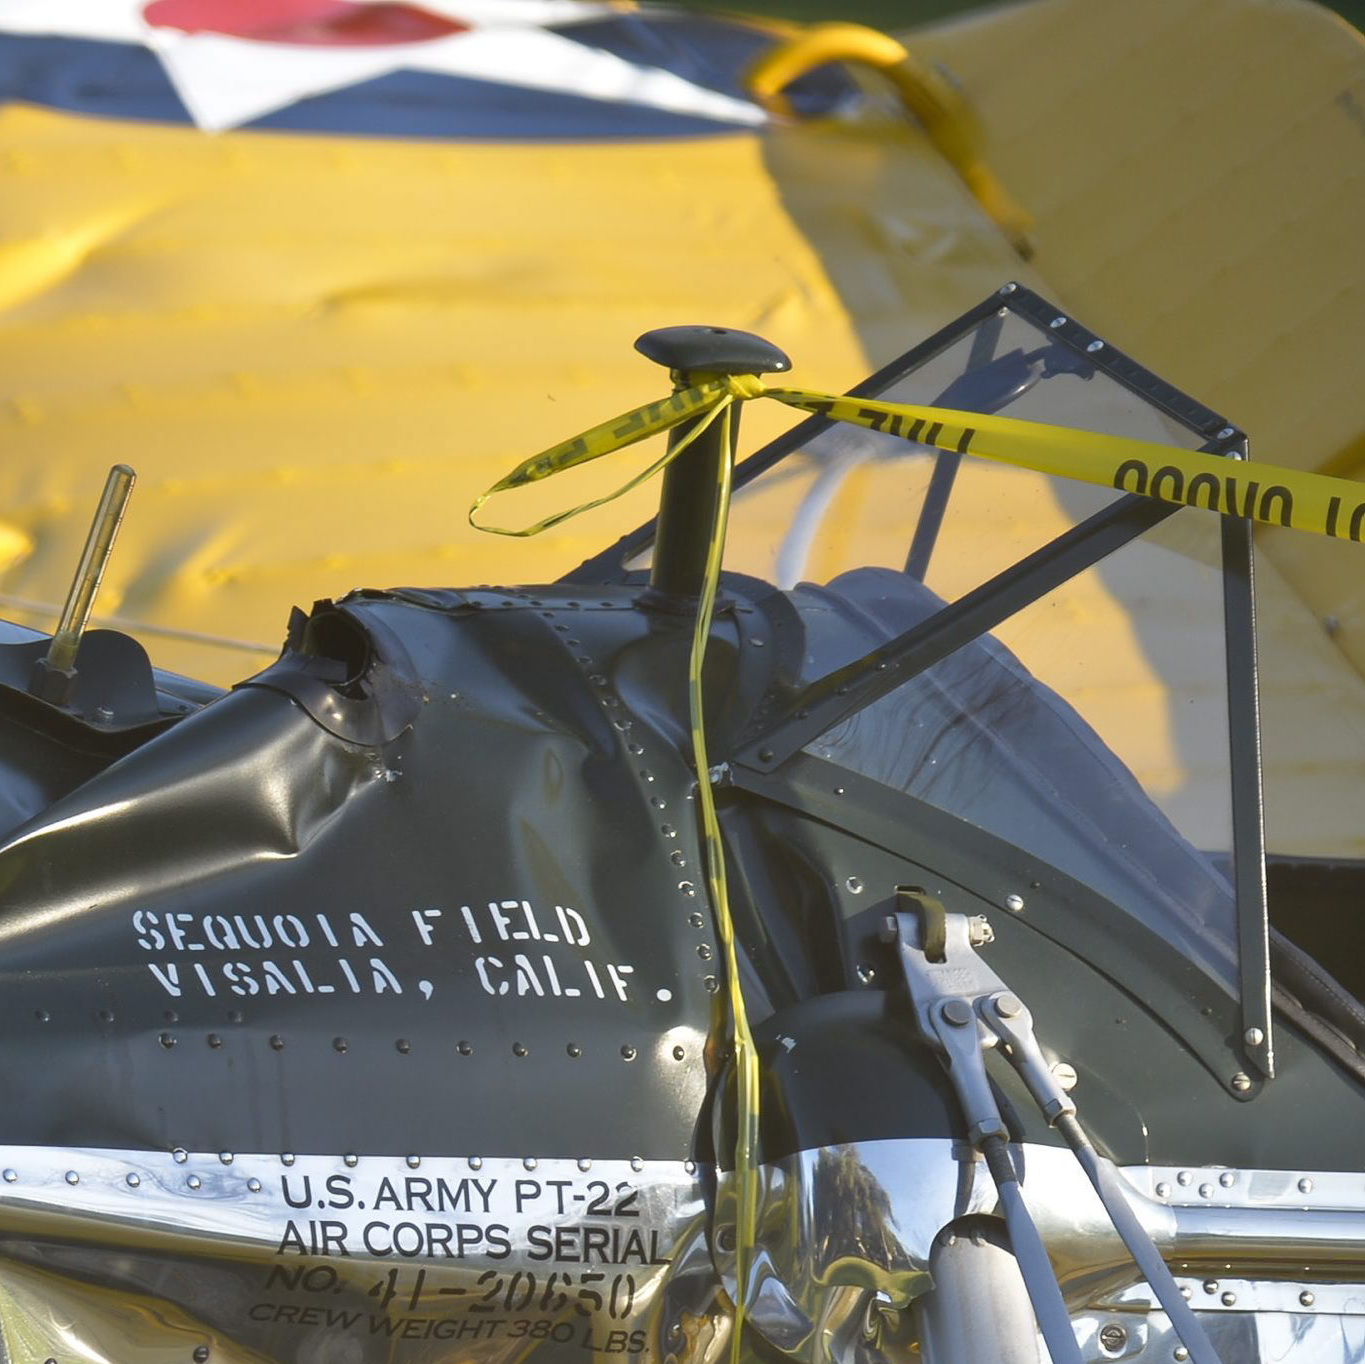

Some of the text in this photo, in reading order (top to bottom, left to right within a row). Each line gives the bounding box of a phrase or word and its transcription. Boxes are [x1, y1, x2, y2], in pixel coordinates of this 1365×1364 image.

[132, 900, 591, 951] SEQUOIA FIELD
[148, 954, 673, 1002] VISALIA, CALIF.
[280, 1174, 641, 1218] U.S. ARMY PT-22
[276, 1219, 673, 1266] AIR CORPS SERIAL
[264, 1263, 636, 1320] NO. 41-20650
[248, 1302, 652, 1355] CREW WEIGHT 380 LBS.
